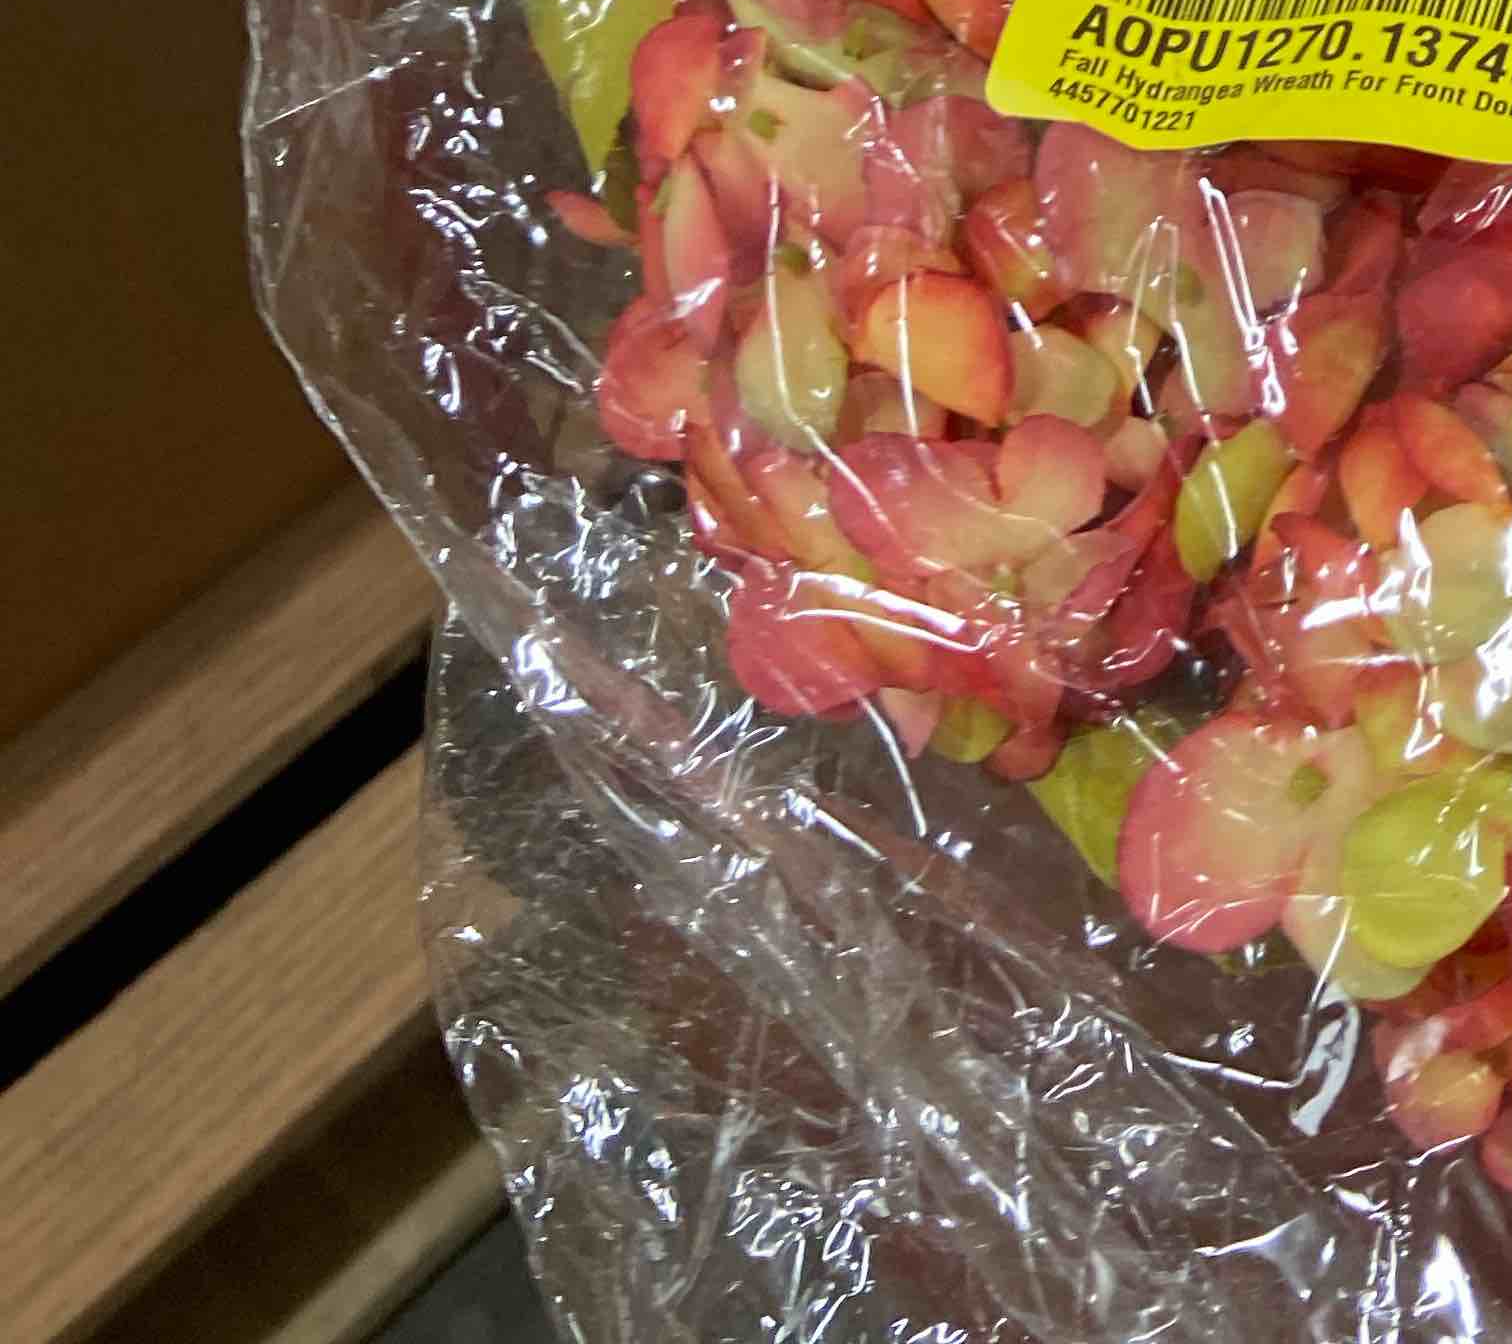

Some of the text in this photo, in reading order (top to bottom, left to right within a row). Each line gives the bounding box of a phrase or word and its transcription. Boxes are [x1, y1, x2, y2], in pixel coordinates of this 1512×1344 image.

[1049, 77, 1197, 131] 4457701221
[1060, 49, 1109, 77] Fall
[1115, 64, 1243, 105] Hydrangea
[1254, 70, 1334, 94] Wreath
[1343, 70, 1386, 92] For
[1395, 75, 1465, 105] Front
